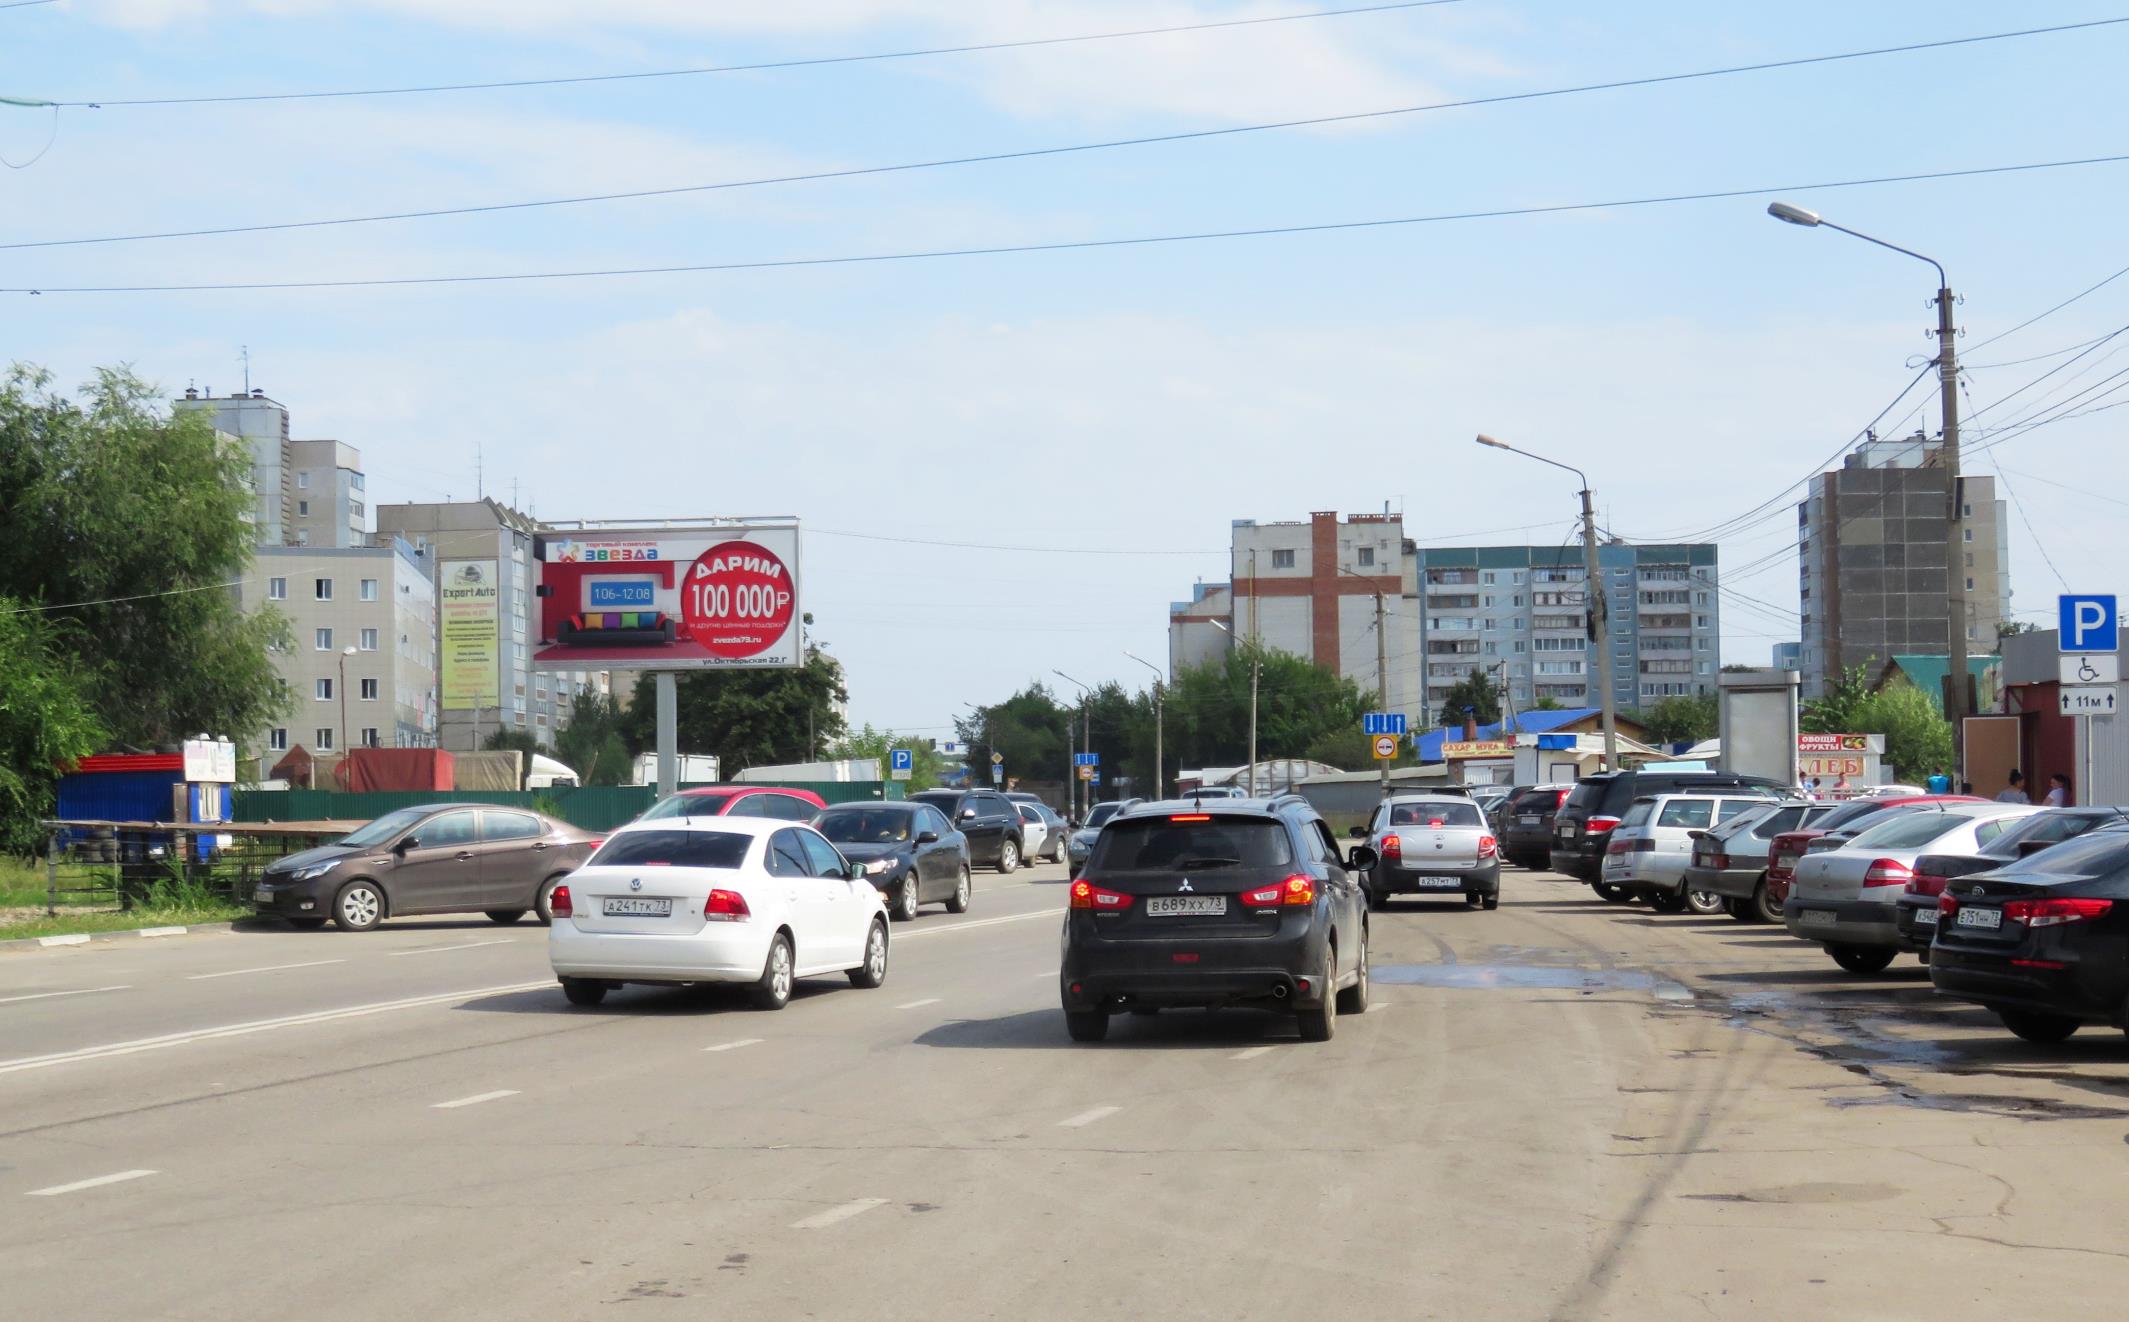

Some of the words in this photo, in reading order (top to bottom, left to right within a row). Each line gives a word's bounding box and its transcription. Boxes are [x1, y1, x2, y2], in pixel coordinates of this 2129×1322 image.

[696, 556, 782, 579] ДАРИМ
[693, 584, 730, 618] 100
[2075, 601, 2106, 646] P
[897, 752, 908, 768] P
